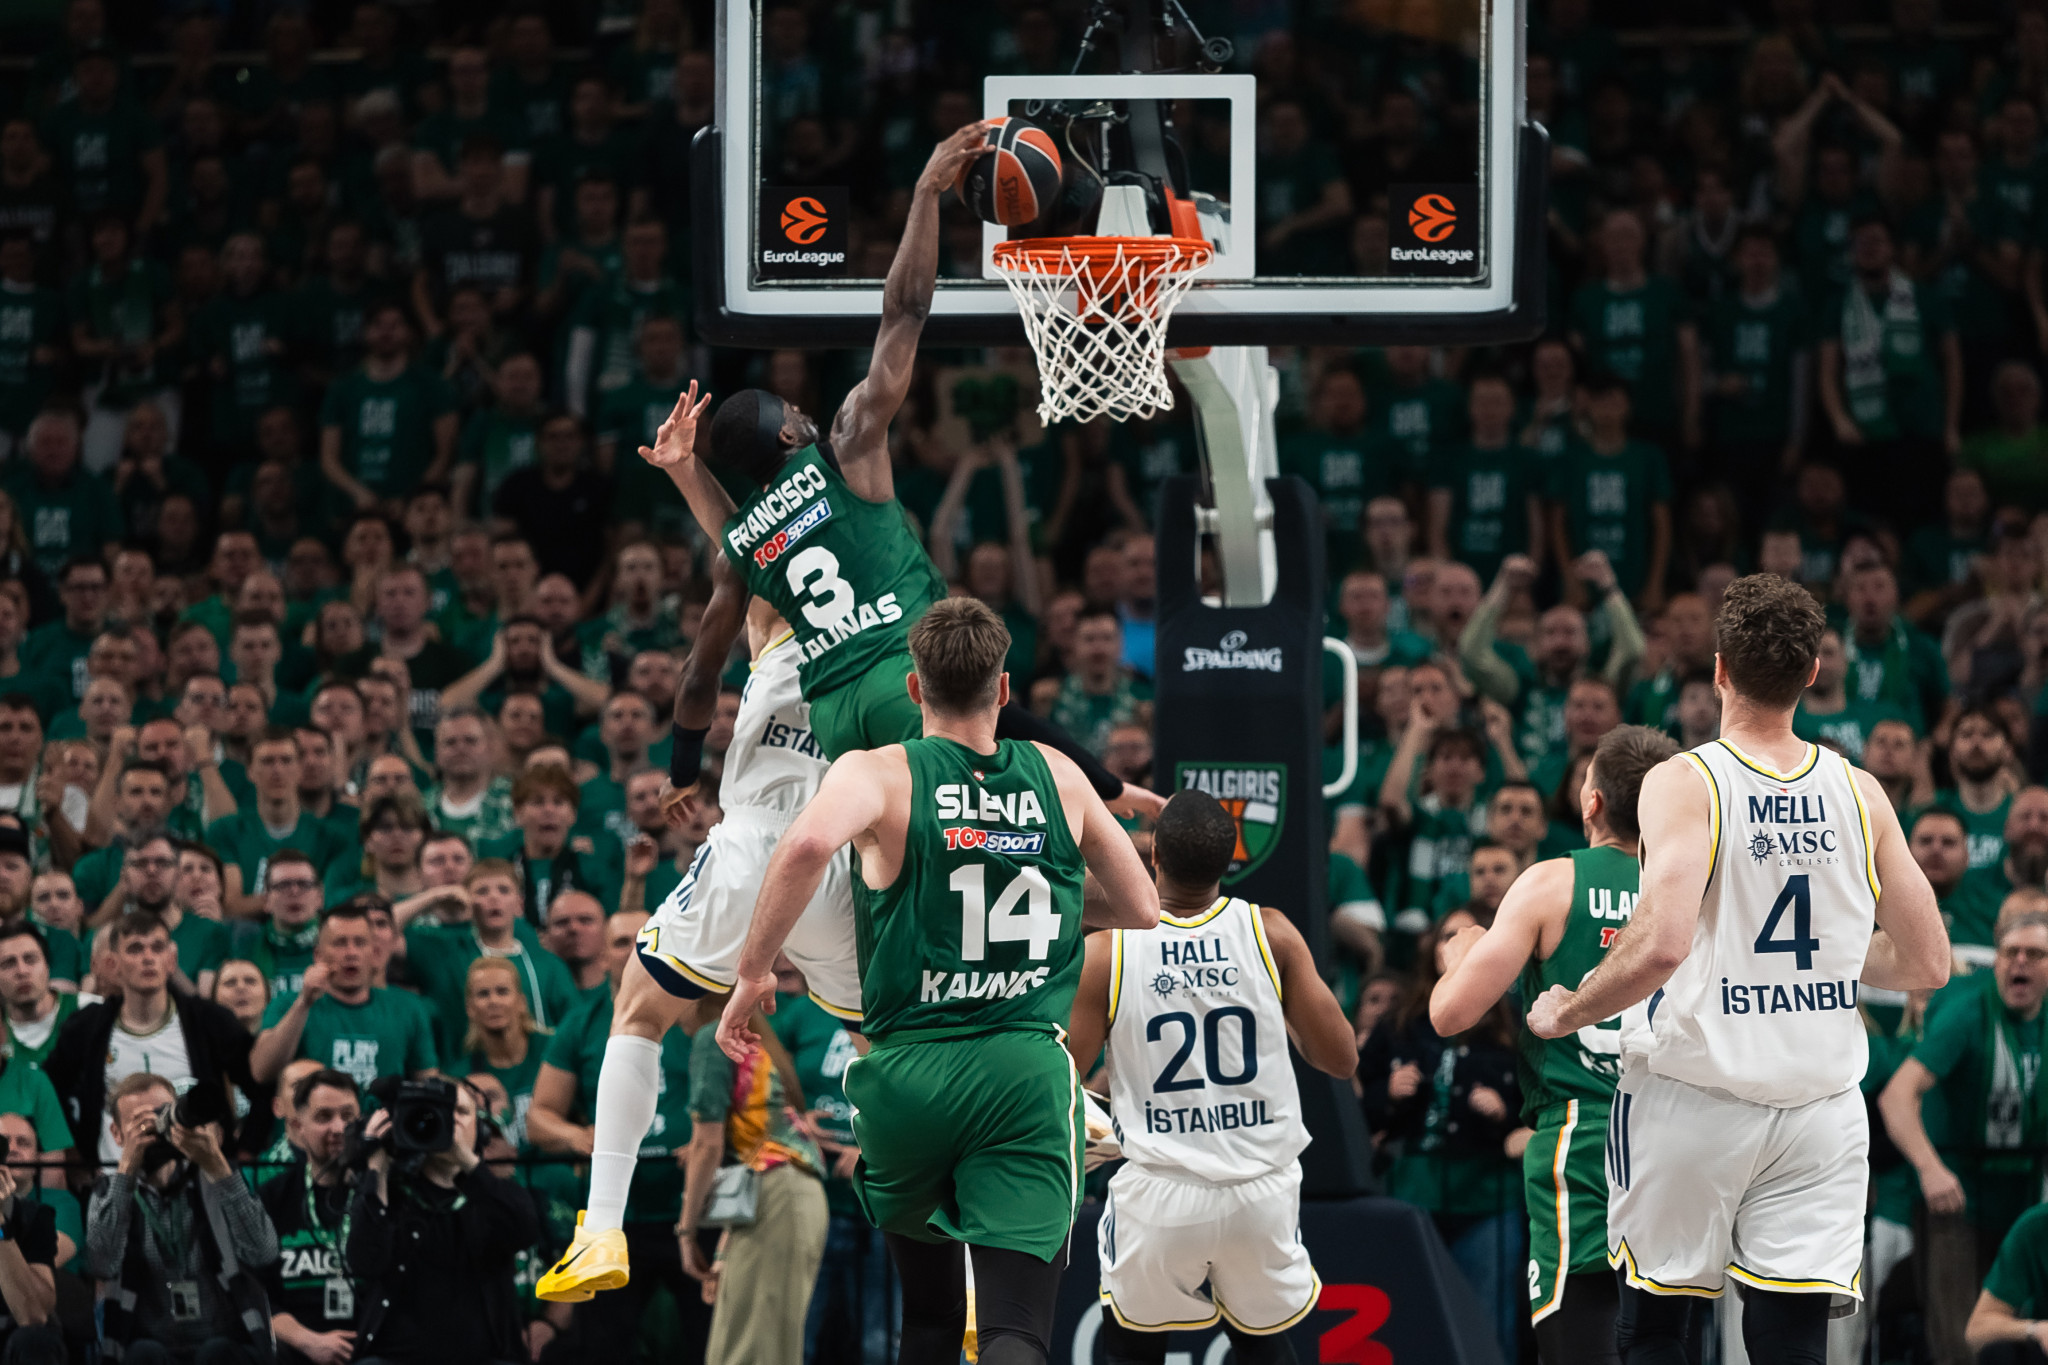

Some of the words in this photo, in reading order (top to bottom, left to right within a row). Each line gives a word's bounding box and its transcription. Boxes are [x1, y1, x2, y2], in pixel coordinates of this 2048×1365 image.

[763, 250, 845, 267] EuroLeague
[1391, 247, 1474, 265] EuroLeague
[728, 463, 827, 557] FRANCISCO
[786, 546, 855, 629] 3
[1182, 647, 1282, 672] SPALDING
[1748, 795, 1826, 824] MELLI
[1777, 830, 1837, 855] MSC
[1779, 857, 1839, 867] CRUISES
[950, 863, 1062, 960] 14
[1754, 874, 1820, 970] 4
[1161, 938, 1229, 965] HALL
[1182, 967, 1239, 989] MSC
[1146, 1006, 1258, 1093] 20
[1145, 1100, 1274, 1134] İSTANBUL
